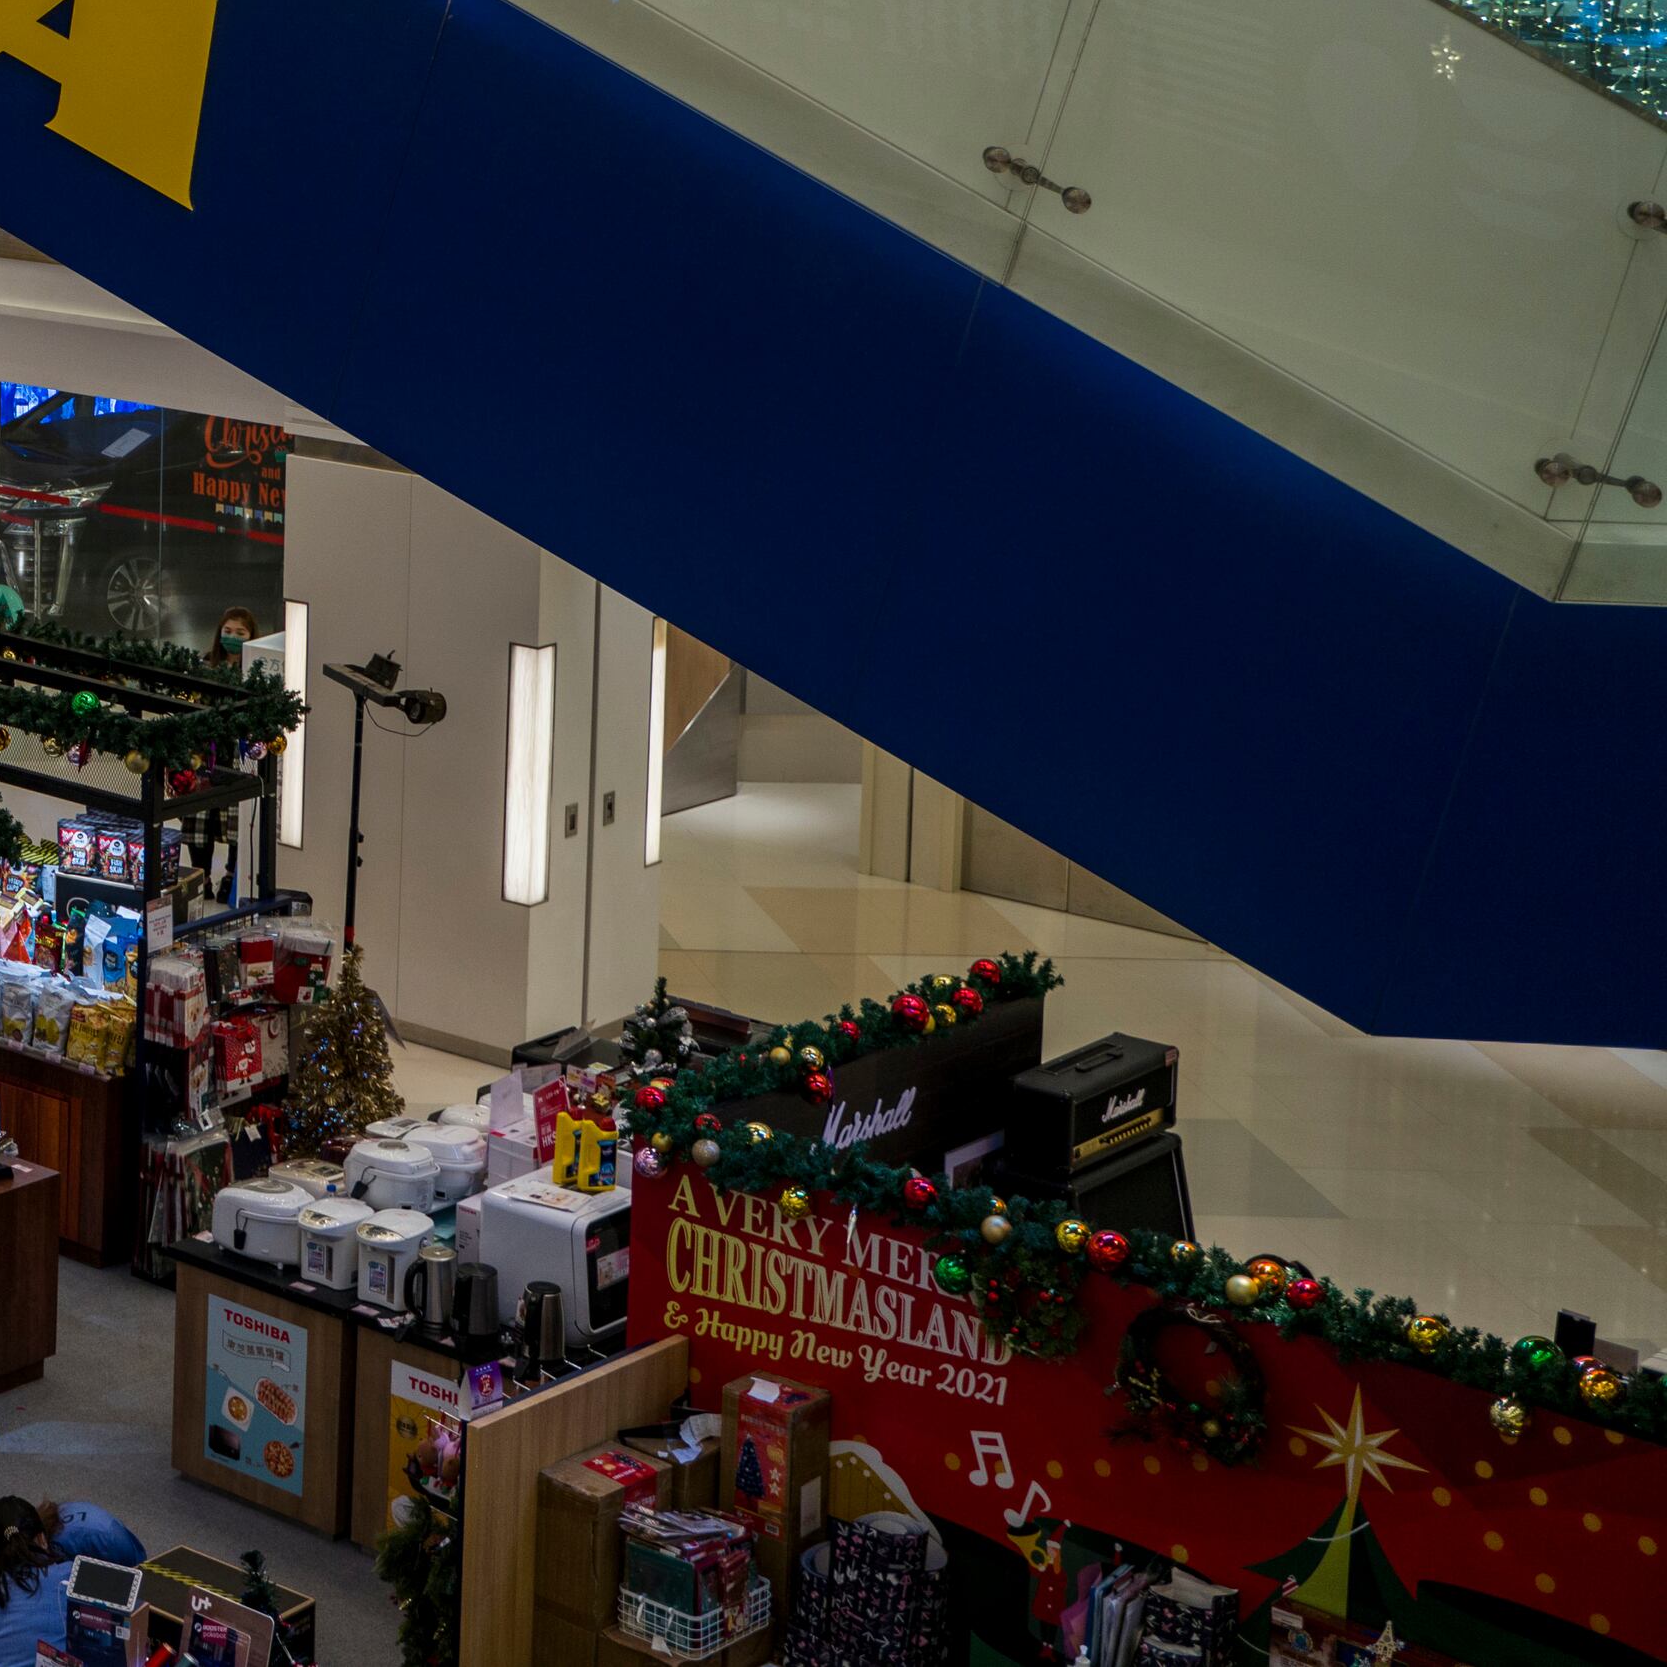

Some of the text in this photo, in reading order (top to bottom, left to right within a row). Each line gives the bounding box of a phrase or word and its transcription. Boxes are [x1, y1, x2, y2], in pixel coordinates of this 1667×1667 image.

[192, 471, 251, 507] Happy
[261, 466, 281, 481] and
[822, 1086, 917, 1150] Marshall
[1100, 1088, 1146, 1123] Marshall
[668, 1174, 967, 1301] A VERY MER
[666, 1217, 1015, 1366] CHRISTMASLAND
[223, 1308, 291, 1344] TOSHIBA
[663, 1301, 1009, 1406] & Happy New Year 2021
